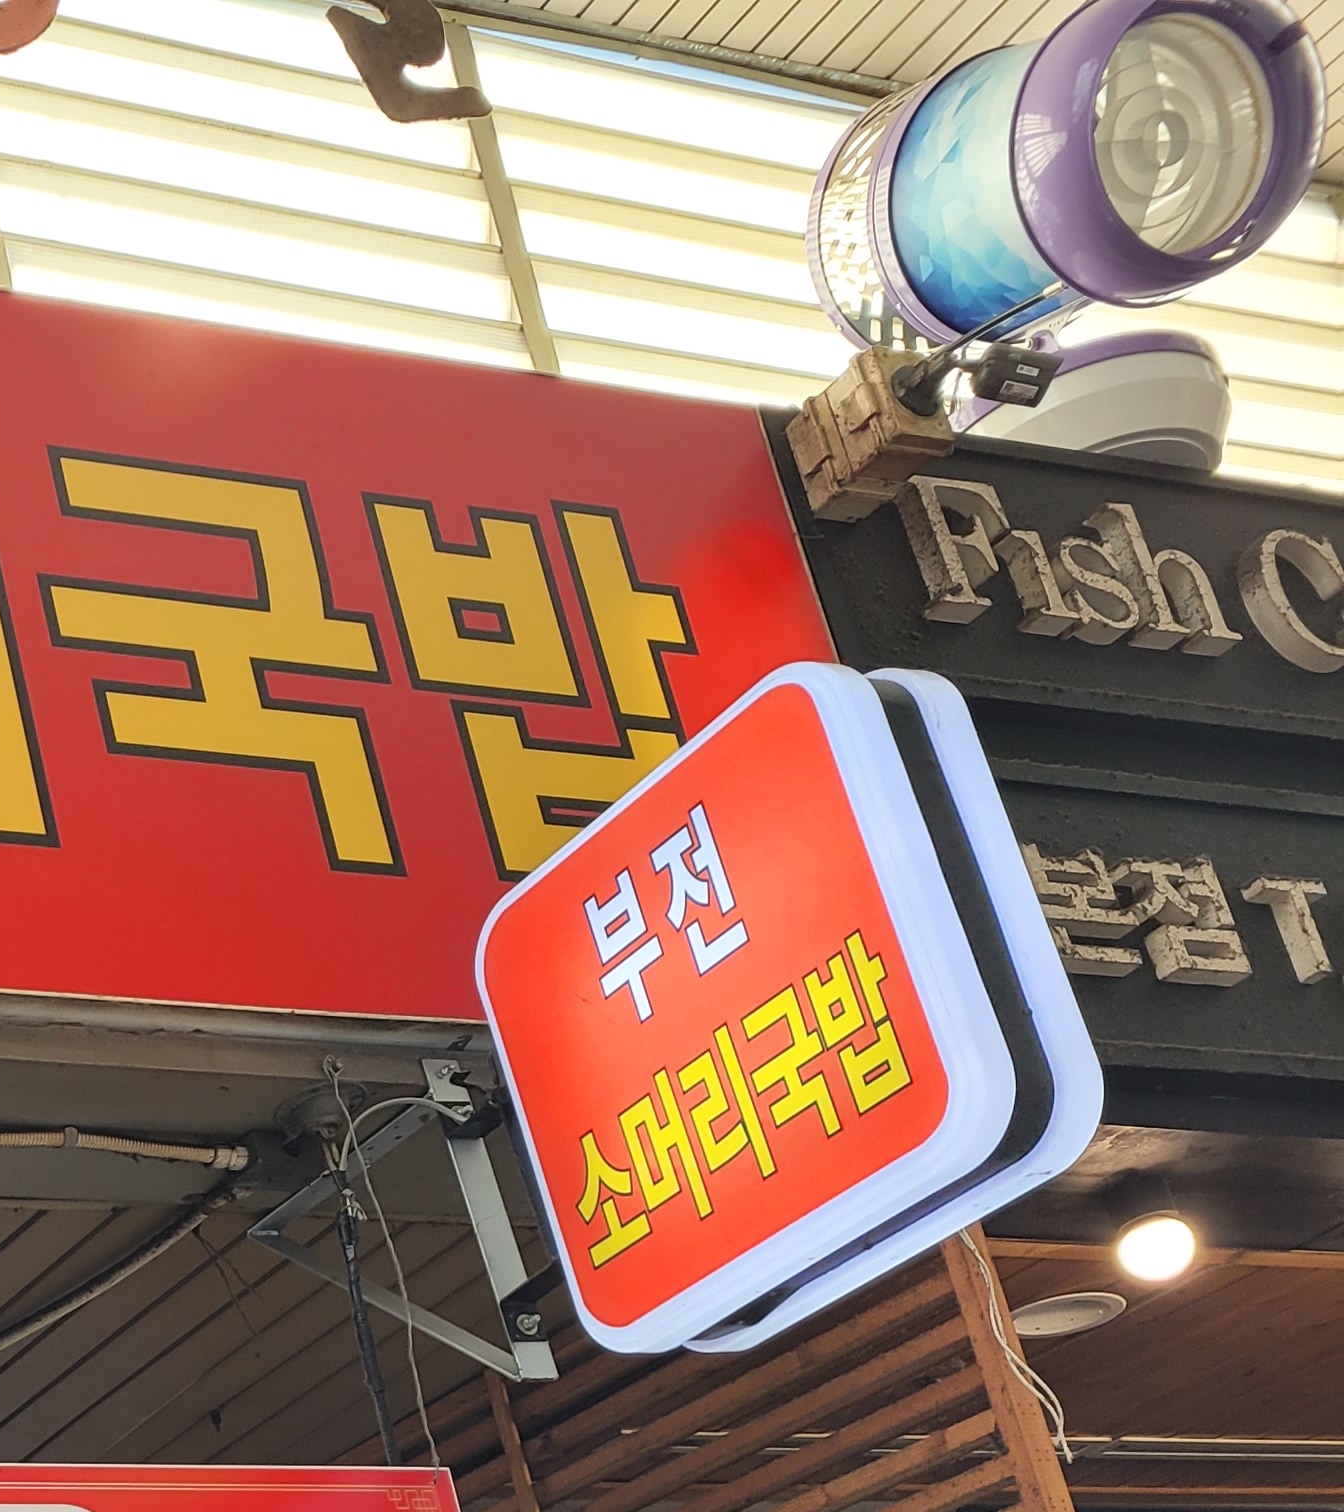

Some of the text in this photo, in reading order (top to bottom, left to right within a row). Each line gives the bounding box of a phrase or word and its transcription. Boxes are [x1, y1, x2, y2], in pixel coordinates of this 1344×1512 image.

[905, 474, 1243, 656] Fish
[582, 800, 750, 1024] 부전
[1019, 840, 1253, 988] 본점
[575, 928, 914, 1270] 소머리국밥
